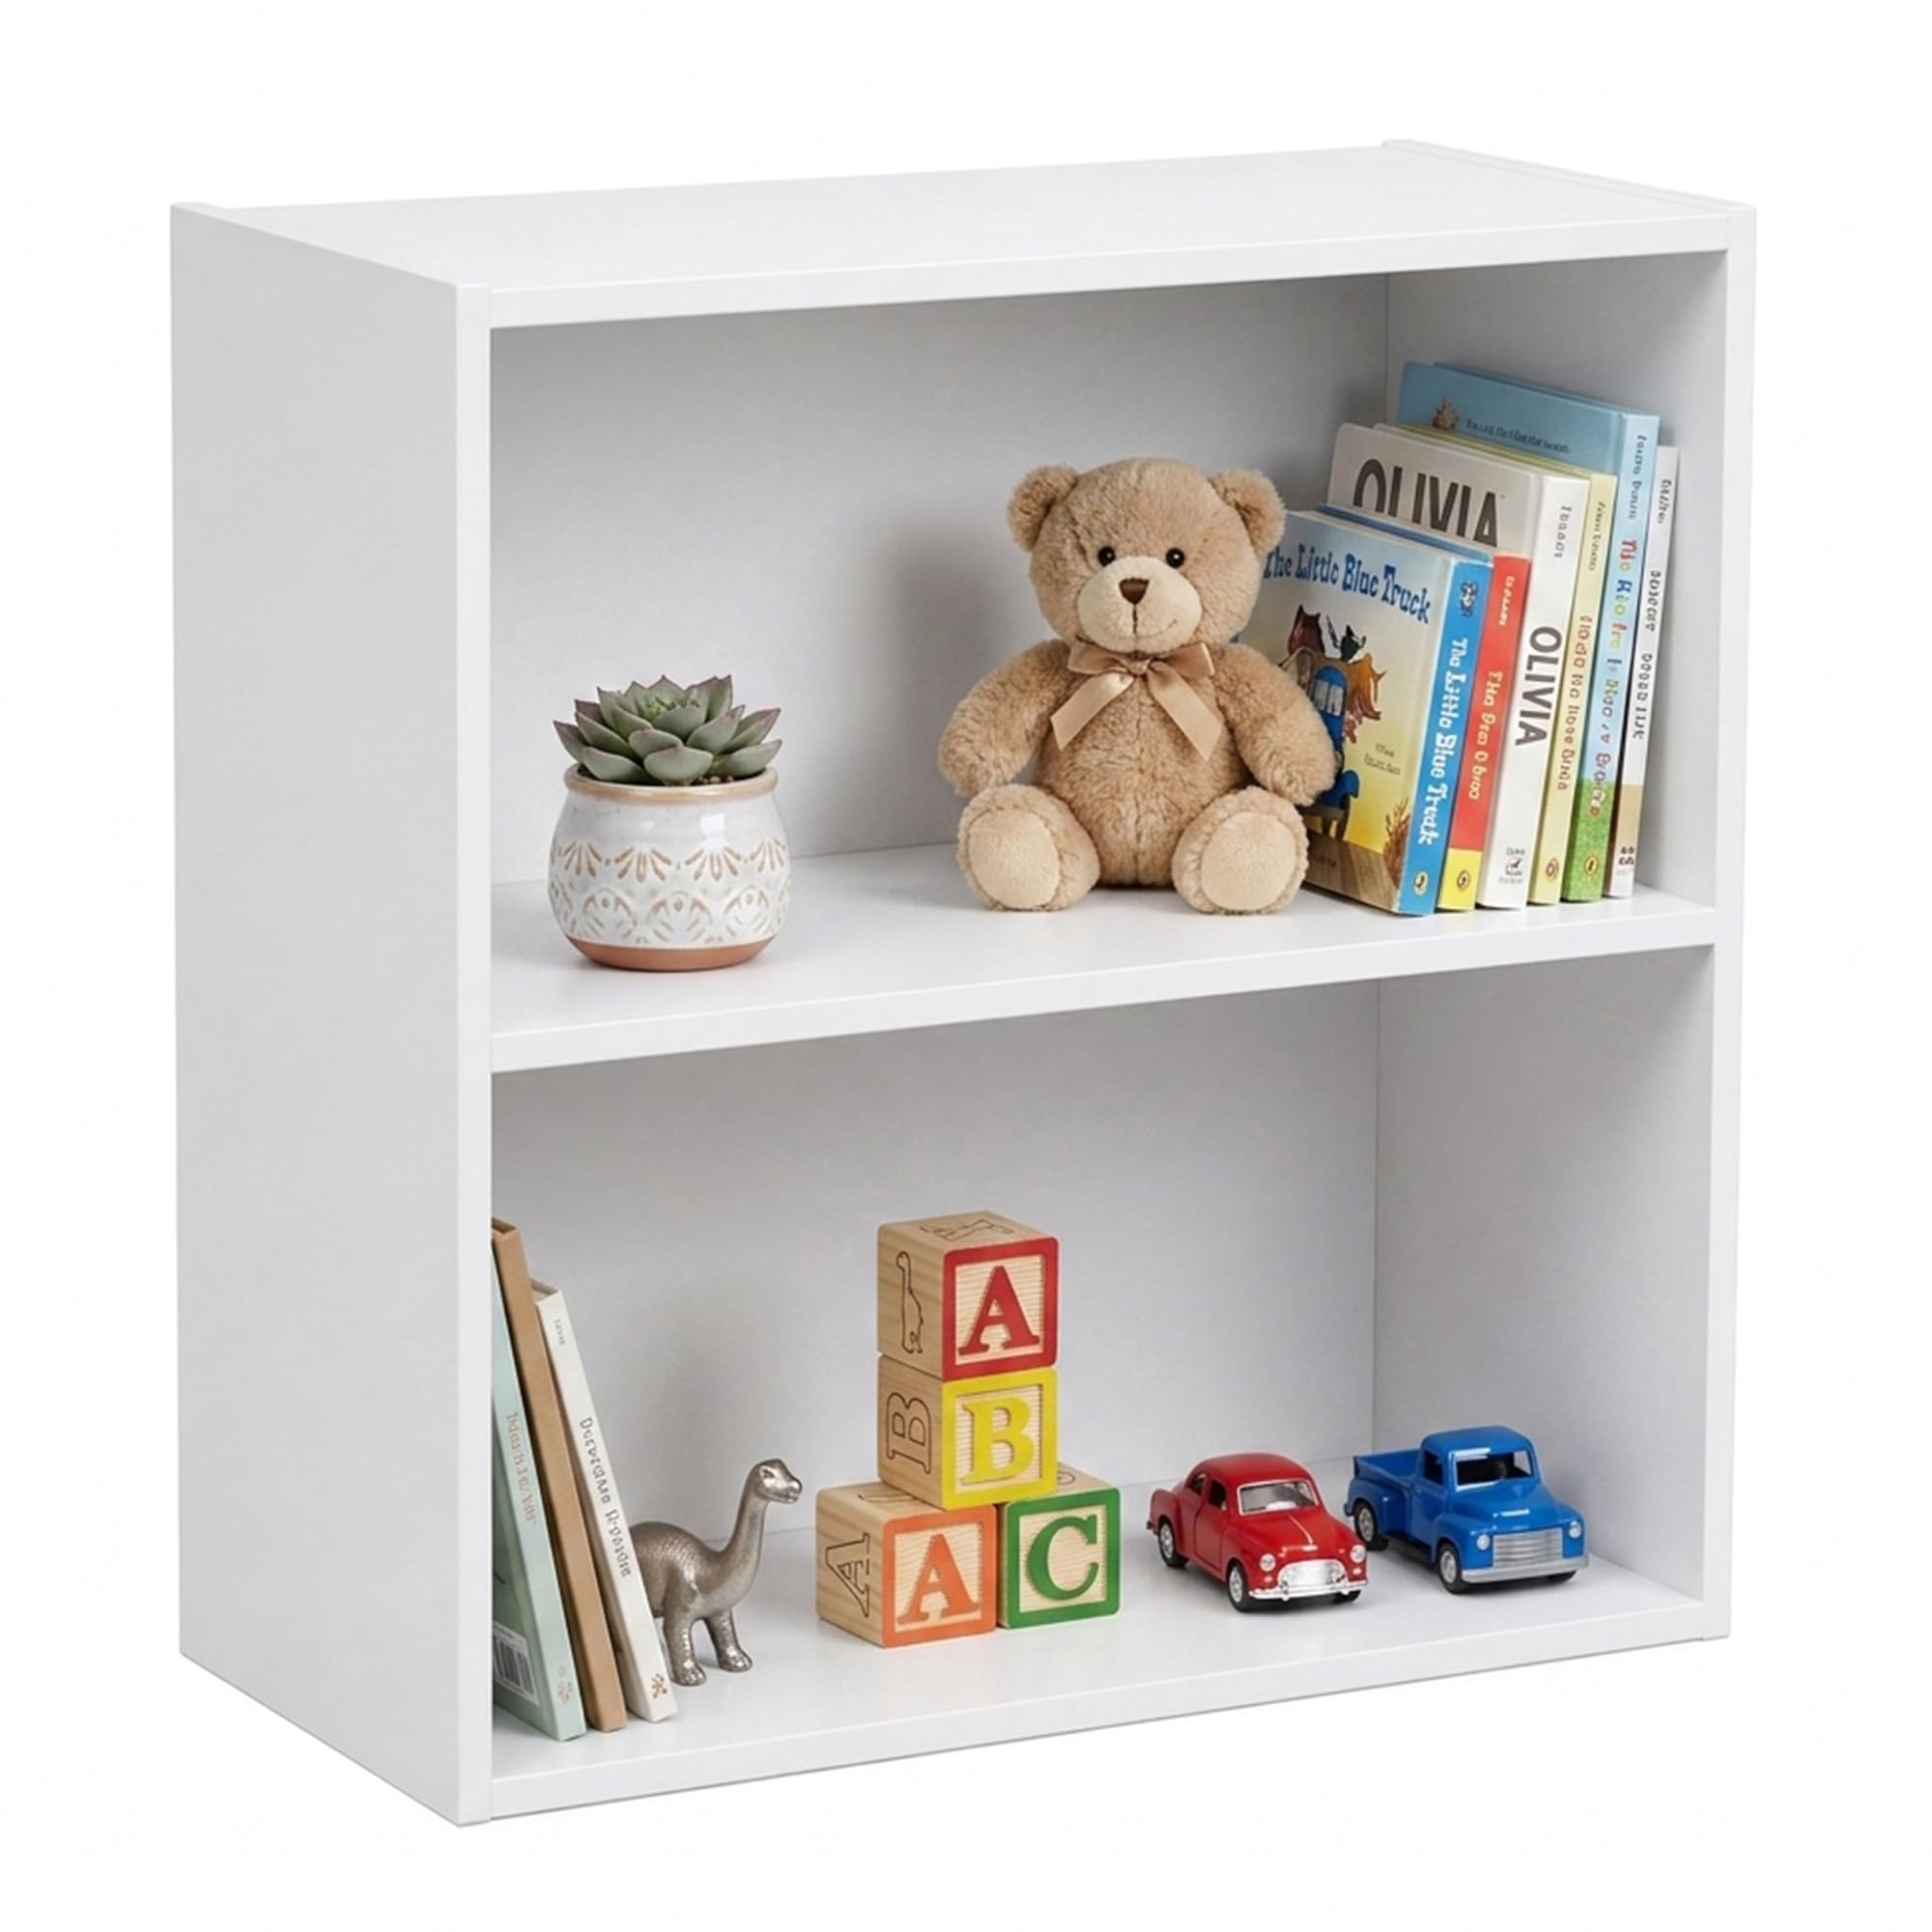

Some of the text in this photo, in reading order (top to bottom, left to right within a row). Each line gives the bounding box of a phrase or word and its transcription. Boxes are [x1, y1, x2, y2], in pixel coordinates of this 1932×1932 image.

[1342, 553, 1380, 597] Blue
[1381, 563, 1431, 624] Truck
[1515, 626, 1562, 747] OLIVIA
[957, 1264, 1040, 1356] A
[886, 1391, 931, 1475] B
[959, 1398, 1035, 1485] B
[825, 1531, 869, 1618] A
[897, 1533, 980, 1625] A
[1026, 1514, 1099, 1601] C
